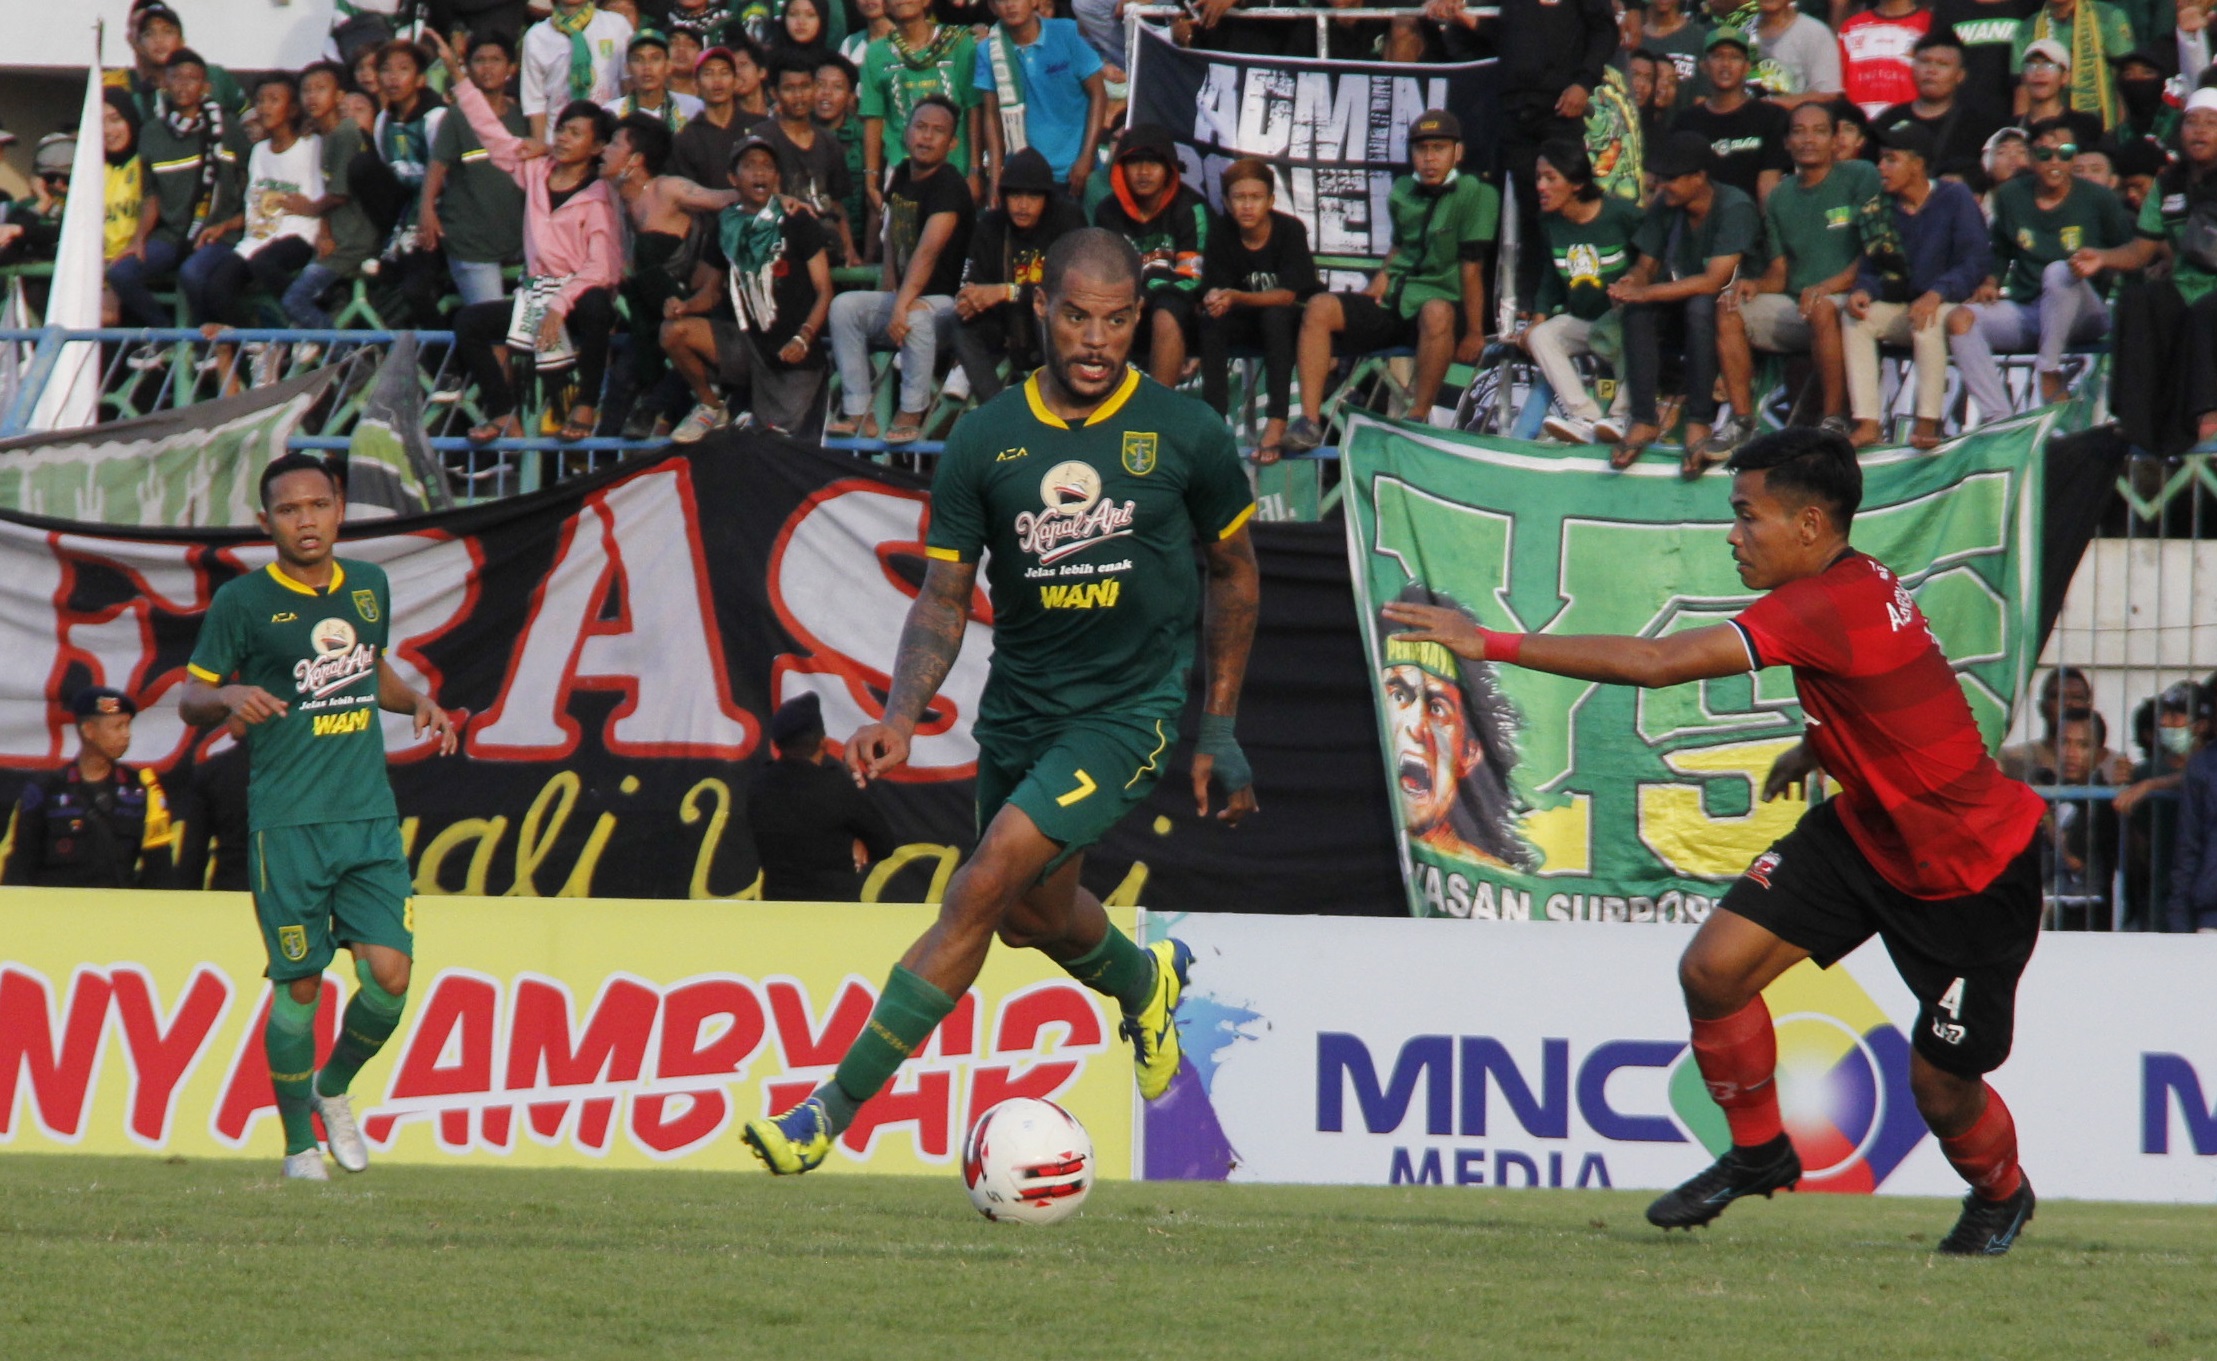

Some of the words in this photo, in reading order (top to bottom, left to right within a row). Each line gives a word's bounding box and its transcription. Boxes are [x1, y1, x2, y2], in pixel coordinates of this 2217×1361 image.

[1014, 505, 1084, 555] Kapal
[1083, 497, 1136, 539] Api
[1024, 566, 1056, 579] Jelas
[1059, 562, 1094, 576] lebih
[1097, 559, 1132, 573] enak
[1040, 576, 1119, 609] WANI
[293, 653, 346, 693] Kapal
[345, 643, 376, 677] Api
[1055, 768, 1098, 808] 7
[1938, 976, 1965, 1020] 4
[1316, 1031, 1690, 1143] MNC
[1388, 1146, 1615, 1189] MEDIA
